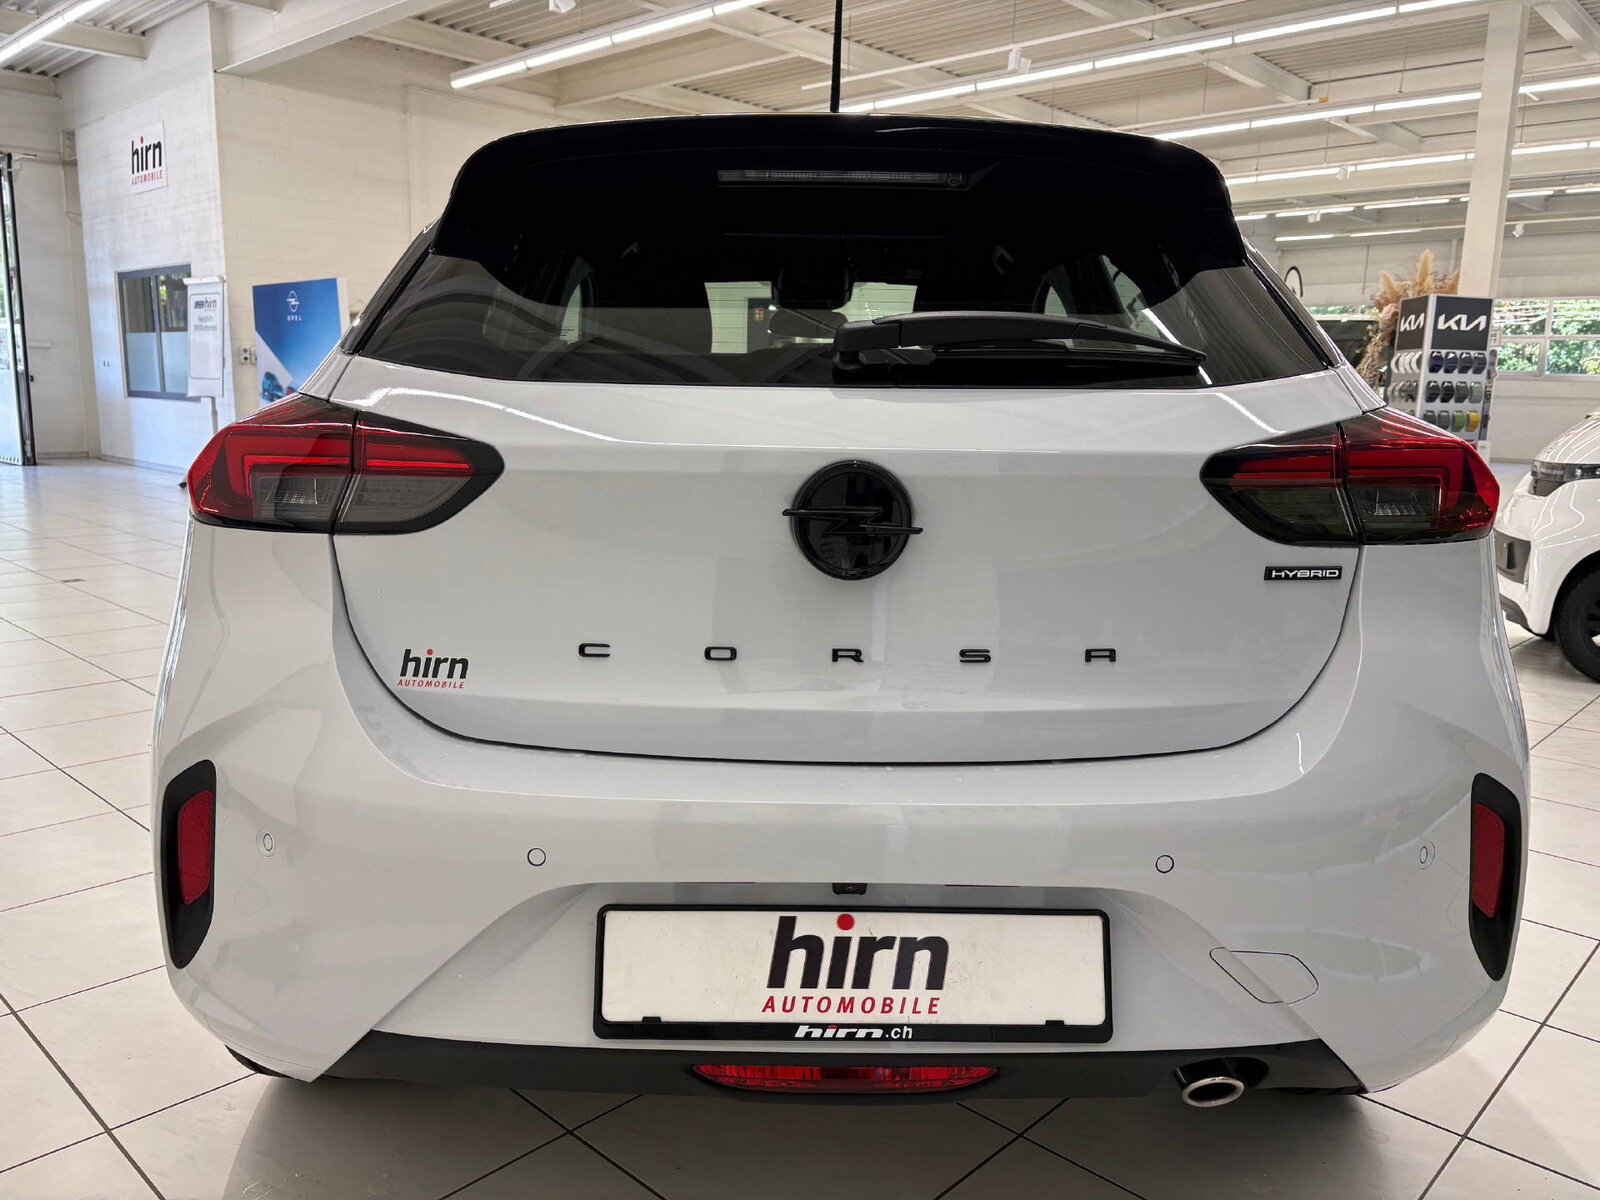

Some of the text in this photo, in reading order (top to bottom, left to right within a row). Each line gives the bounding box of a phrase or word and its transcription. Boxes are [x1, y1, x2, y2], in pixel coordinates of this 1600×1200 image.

[131, 136, 162, 175] hirn
[131, 169, 163, 186] AUTOMOBILE
[1400, 312, 1425, 332] KIA
[1437, 312, 1488, 332] KIA
[1271, 569, 1340, 579] HYBRID
[578, 642, 1117, 664] CORSA
[400, 648, 469, 679] hirn
[397, 678, 465, 689] AUTOMOBILE
[766, 913, 949, 991] hirn
[761, 995, 941, 1015] AUTOMOBILE
[794, 1024, 913, 1040] hirn.ch
